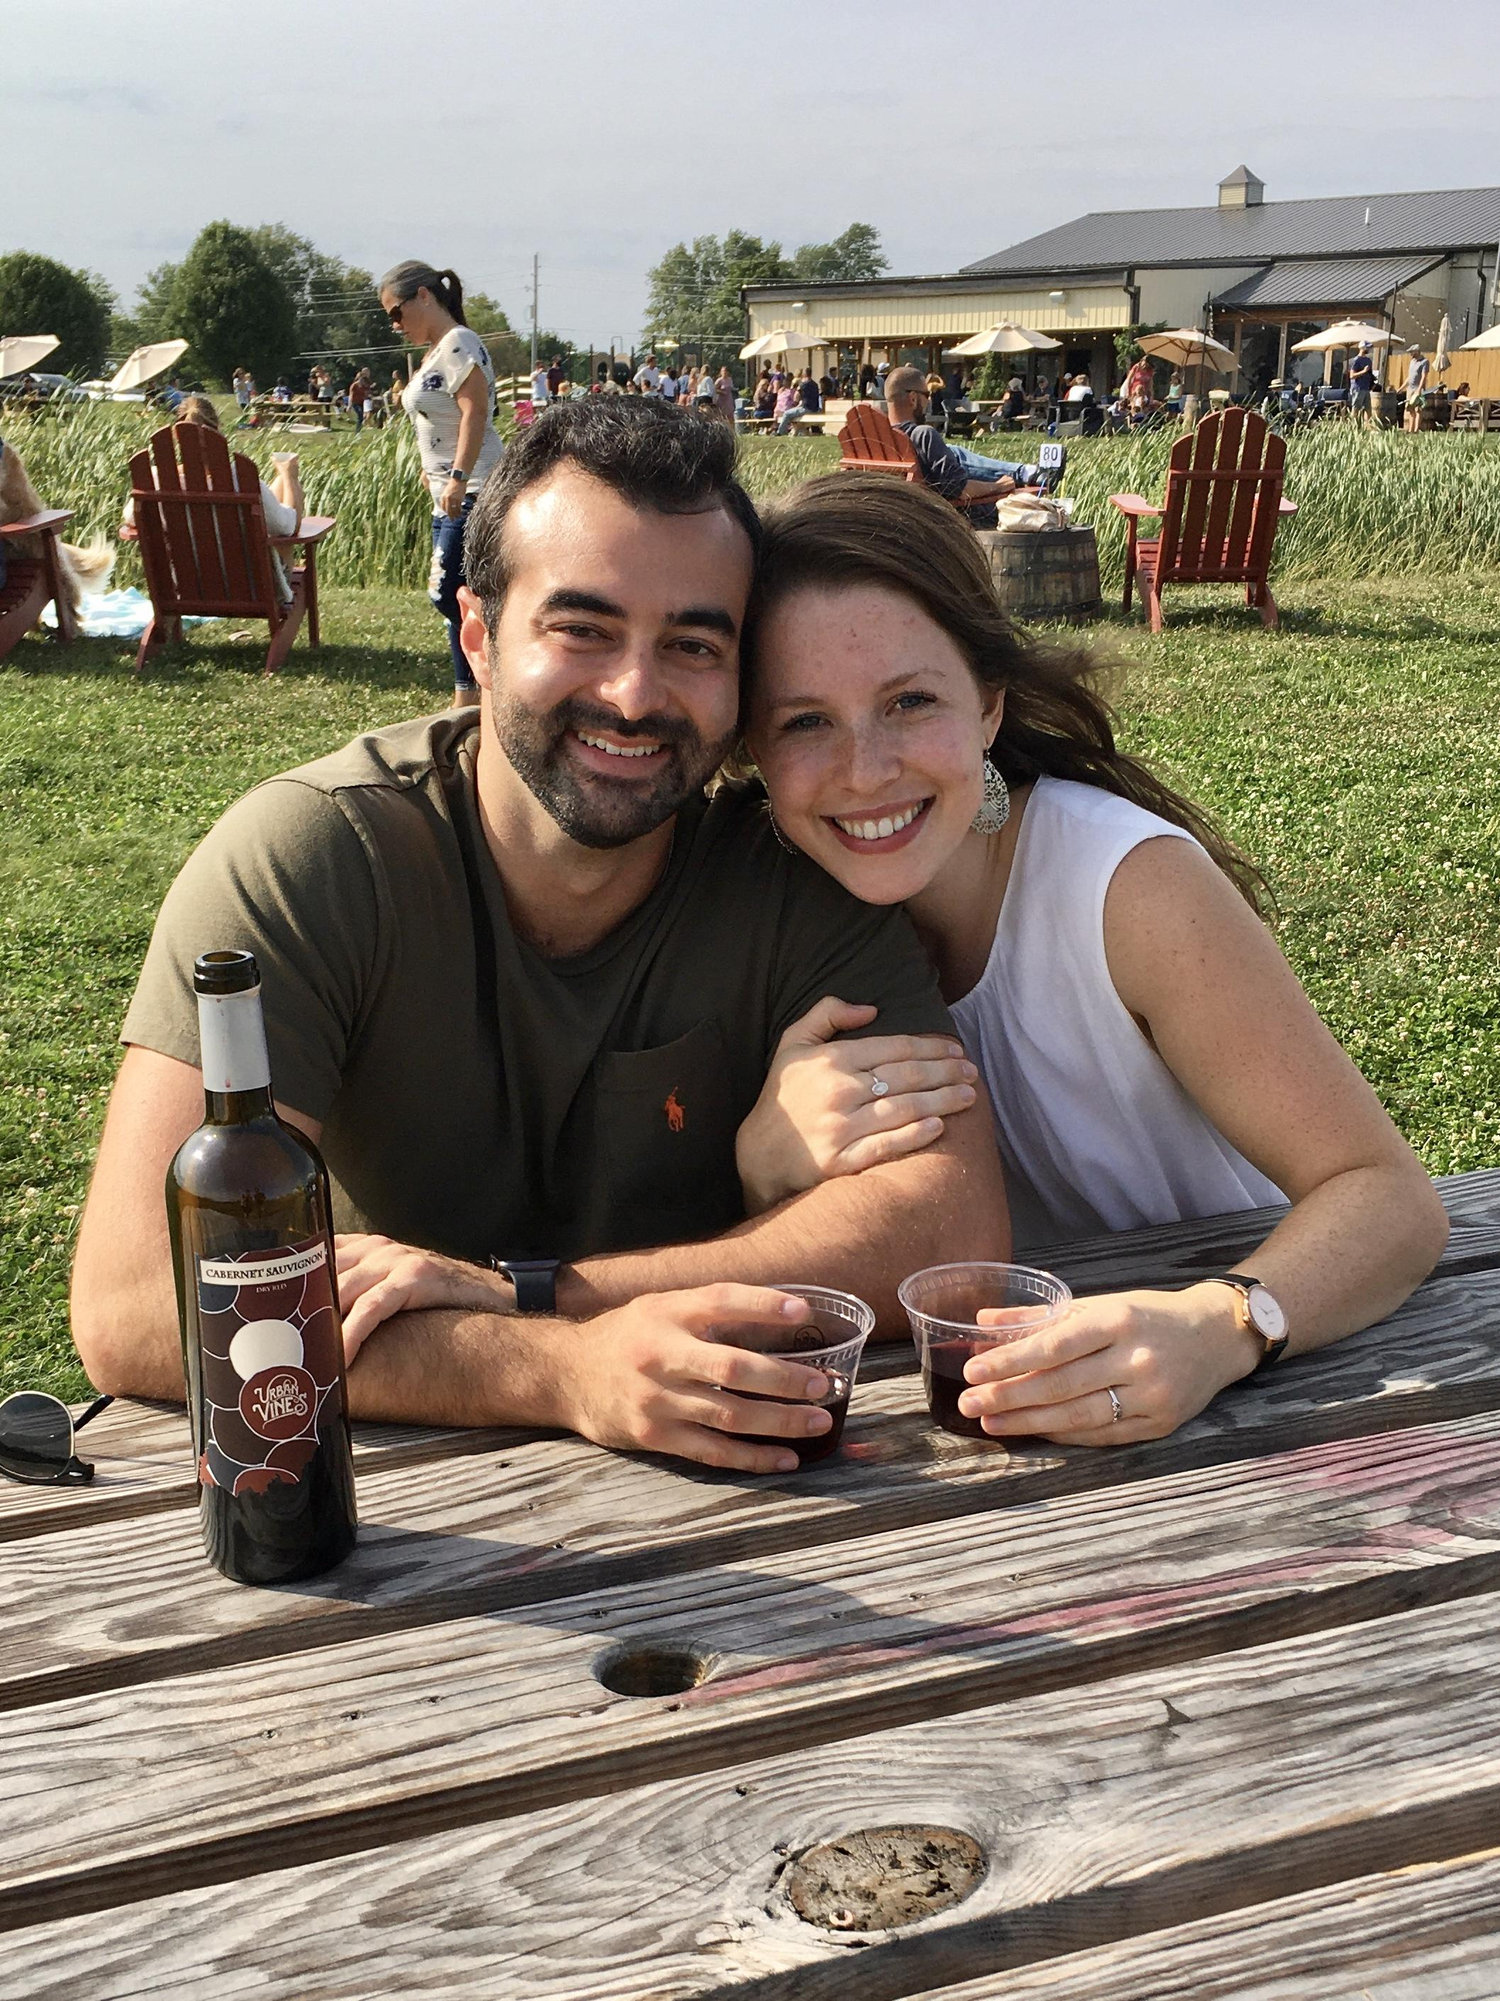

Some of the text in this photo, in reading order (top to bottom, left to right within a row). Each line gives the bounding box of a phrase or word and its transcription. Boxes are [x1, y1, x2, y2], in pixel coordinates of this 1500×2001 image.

[1043, 446, 1058, 462] 80
[205, 1250, 323, 1280] CABERNET SAUVIGNON
[254, 1374, 299, 1403] URBAN
[252, 1392, 308, 1424] VINES
